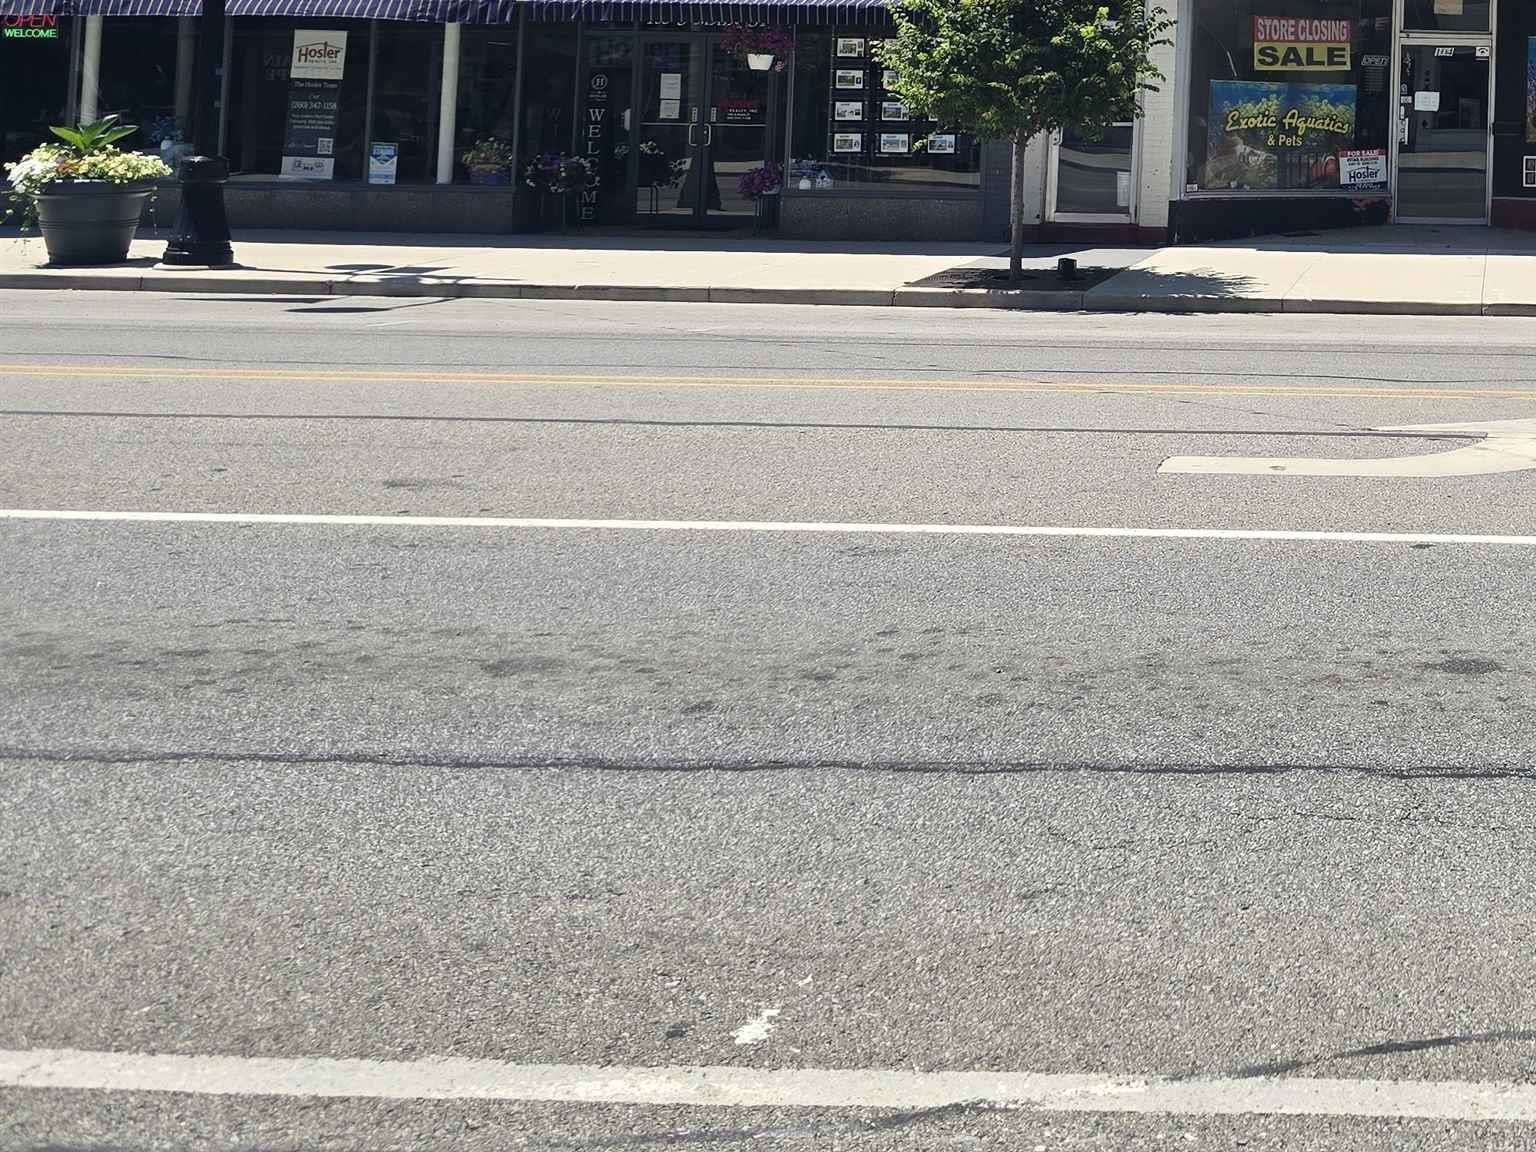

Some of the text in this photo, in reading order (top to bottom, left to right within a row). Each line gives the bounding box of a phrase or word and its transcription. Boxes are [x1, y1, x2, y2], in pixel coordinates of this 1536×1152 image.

[5, 15, 56, 27] OPEN
[1257, 19, 1349, 41] STORE CLOSING
[4, 29, 57, 38] WELCOME
[297, 41, 341, 64] Hosler
[1257, 46, 1348, 67] SALE
[1225, 109, 1350, 135] Exotic Aquatics
[1267, 134, 1303, 147] & Pets
[582, 108, 606, 220] WELME
[1349, 166, 1380, 183] Hosler
